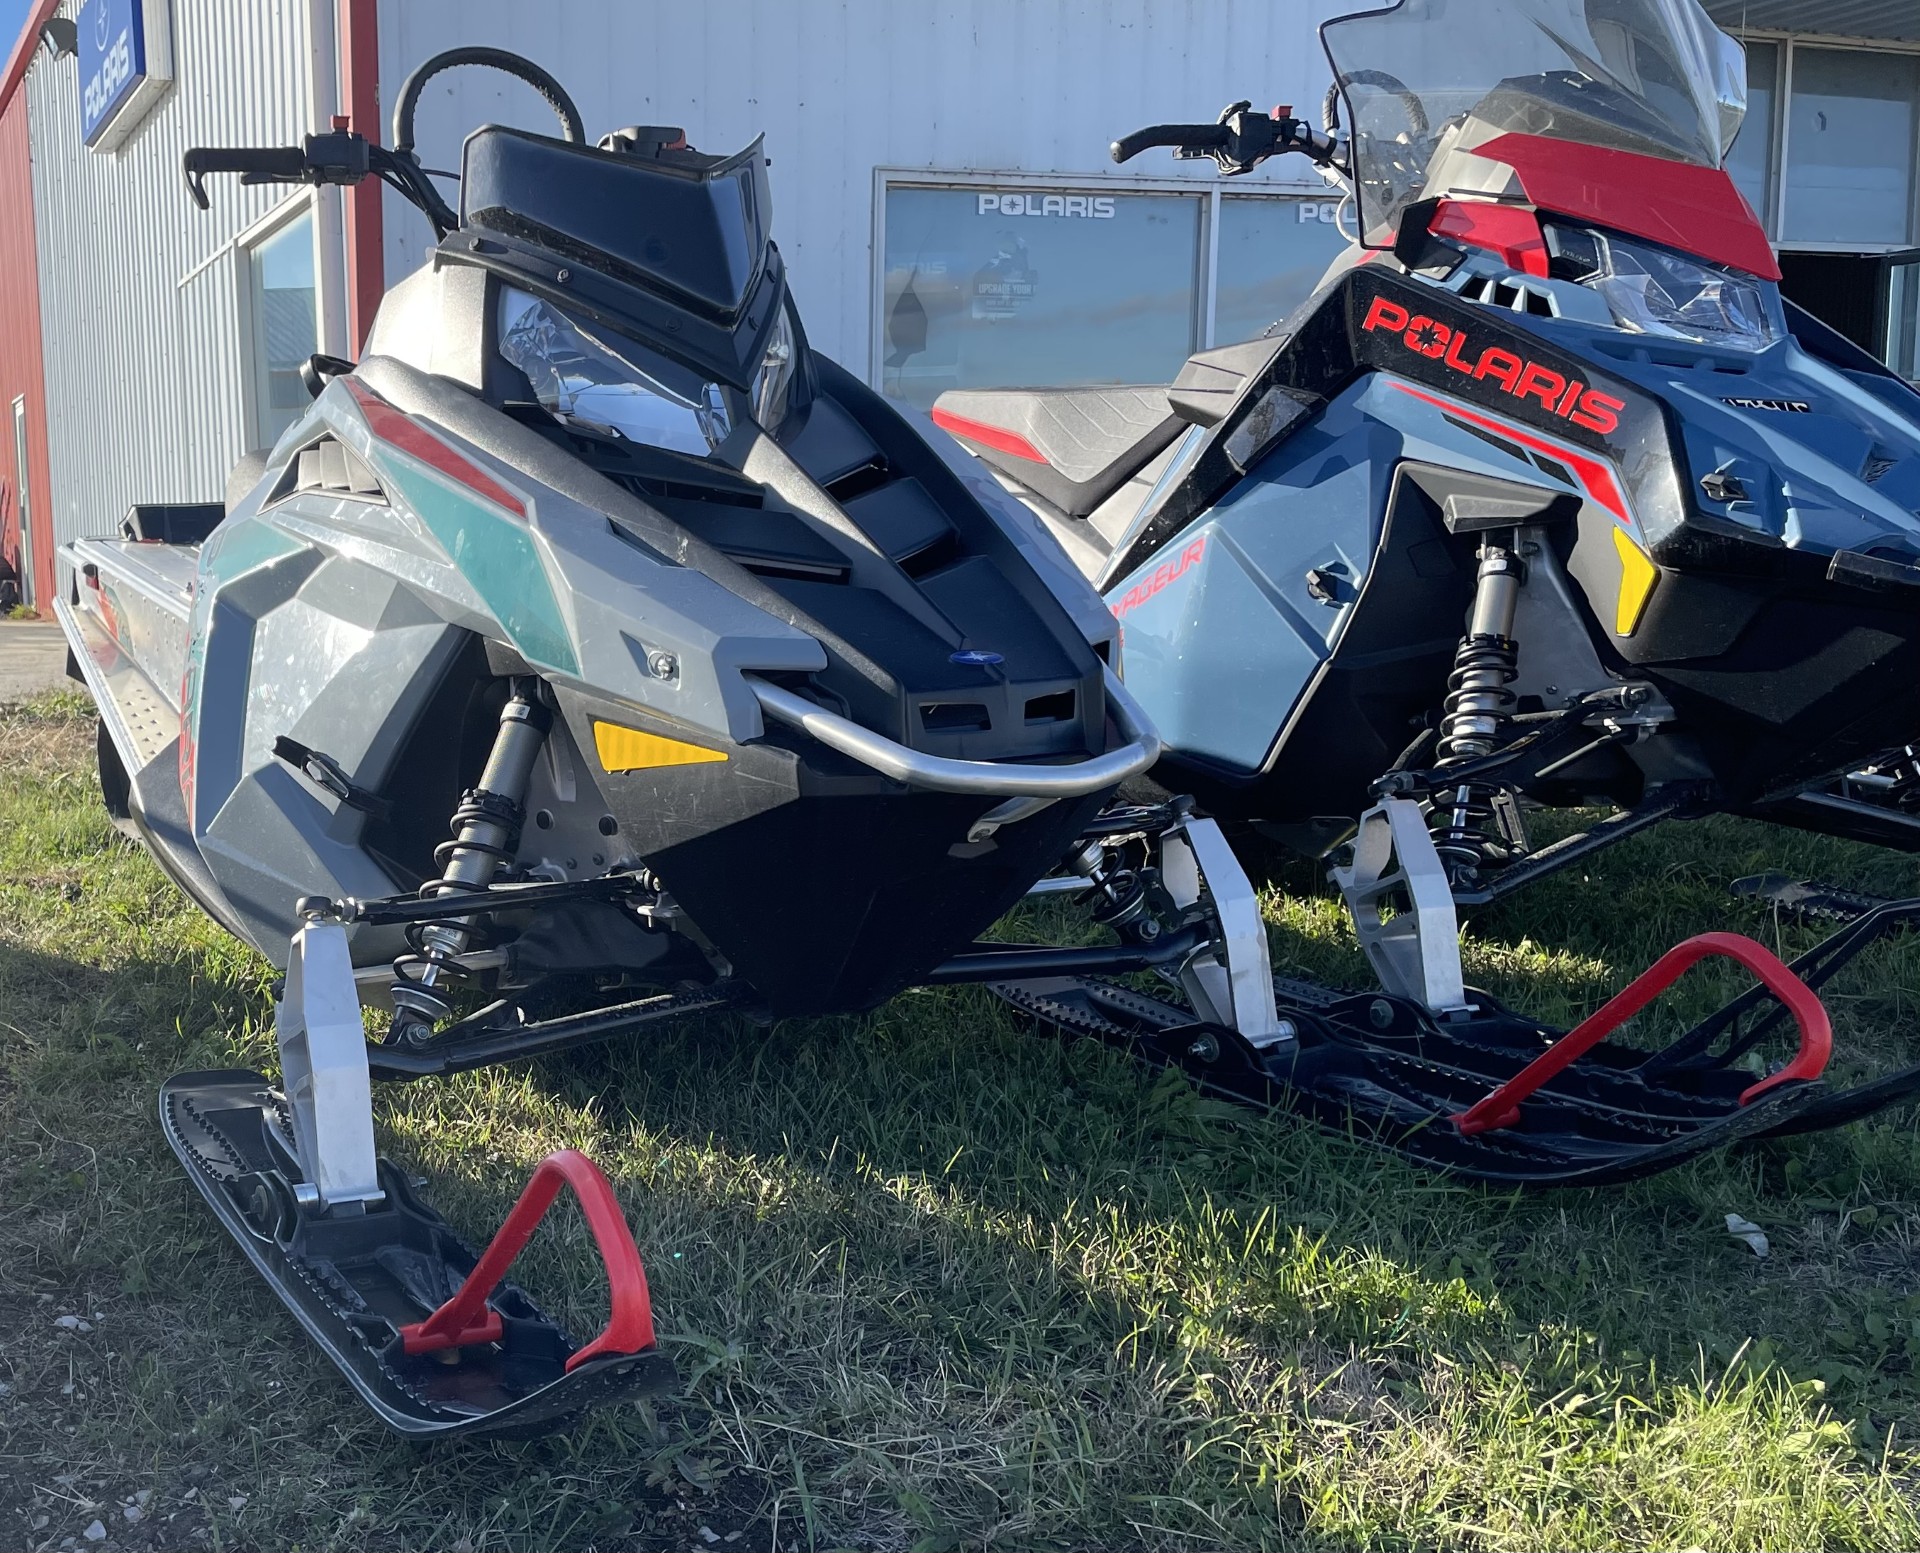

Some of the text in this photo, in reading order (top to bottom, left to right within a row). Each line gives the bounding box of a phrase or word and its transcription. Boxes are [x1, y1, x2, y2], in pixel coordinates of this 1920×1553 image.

[84, 26, 129, 130] POLARIS
[978, 193, 1115, 219] POLARIS
[1298, 202, 1357, 224] POL
[1362, 295, 1626, 435] POLARIS
[1109, 536, 1207, 619] YAGEUR
